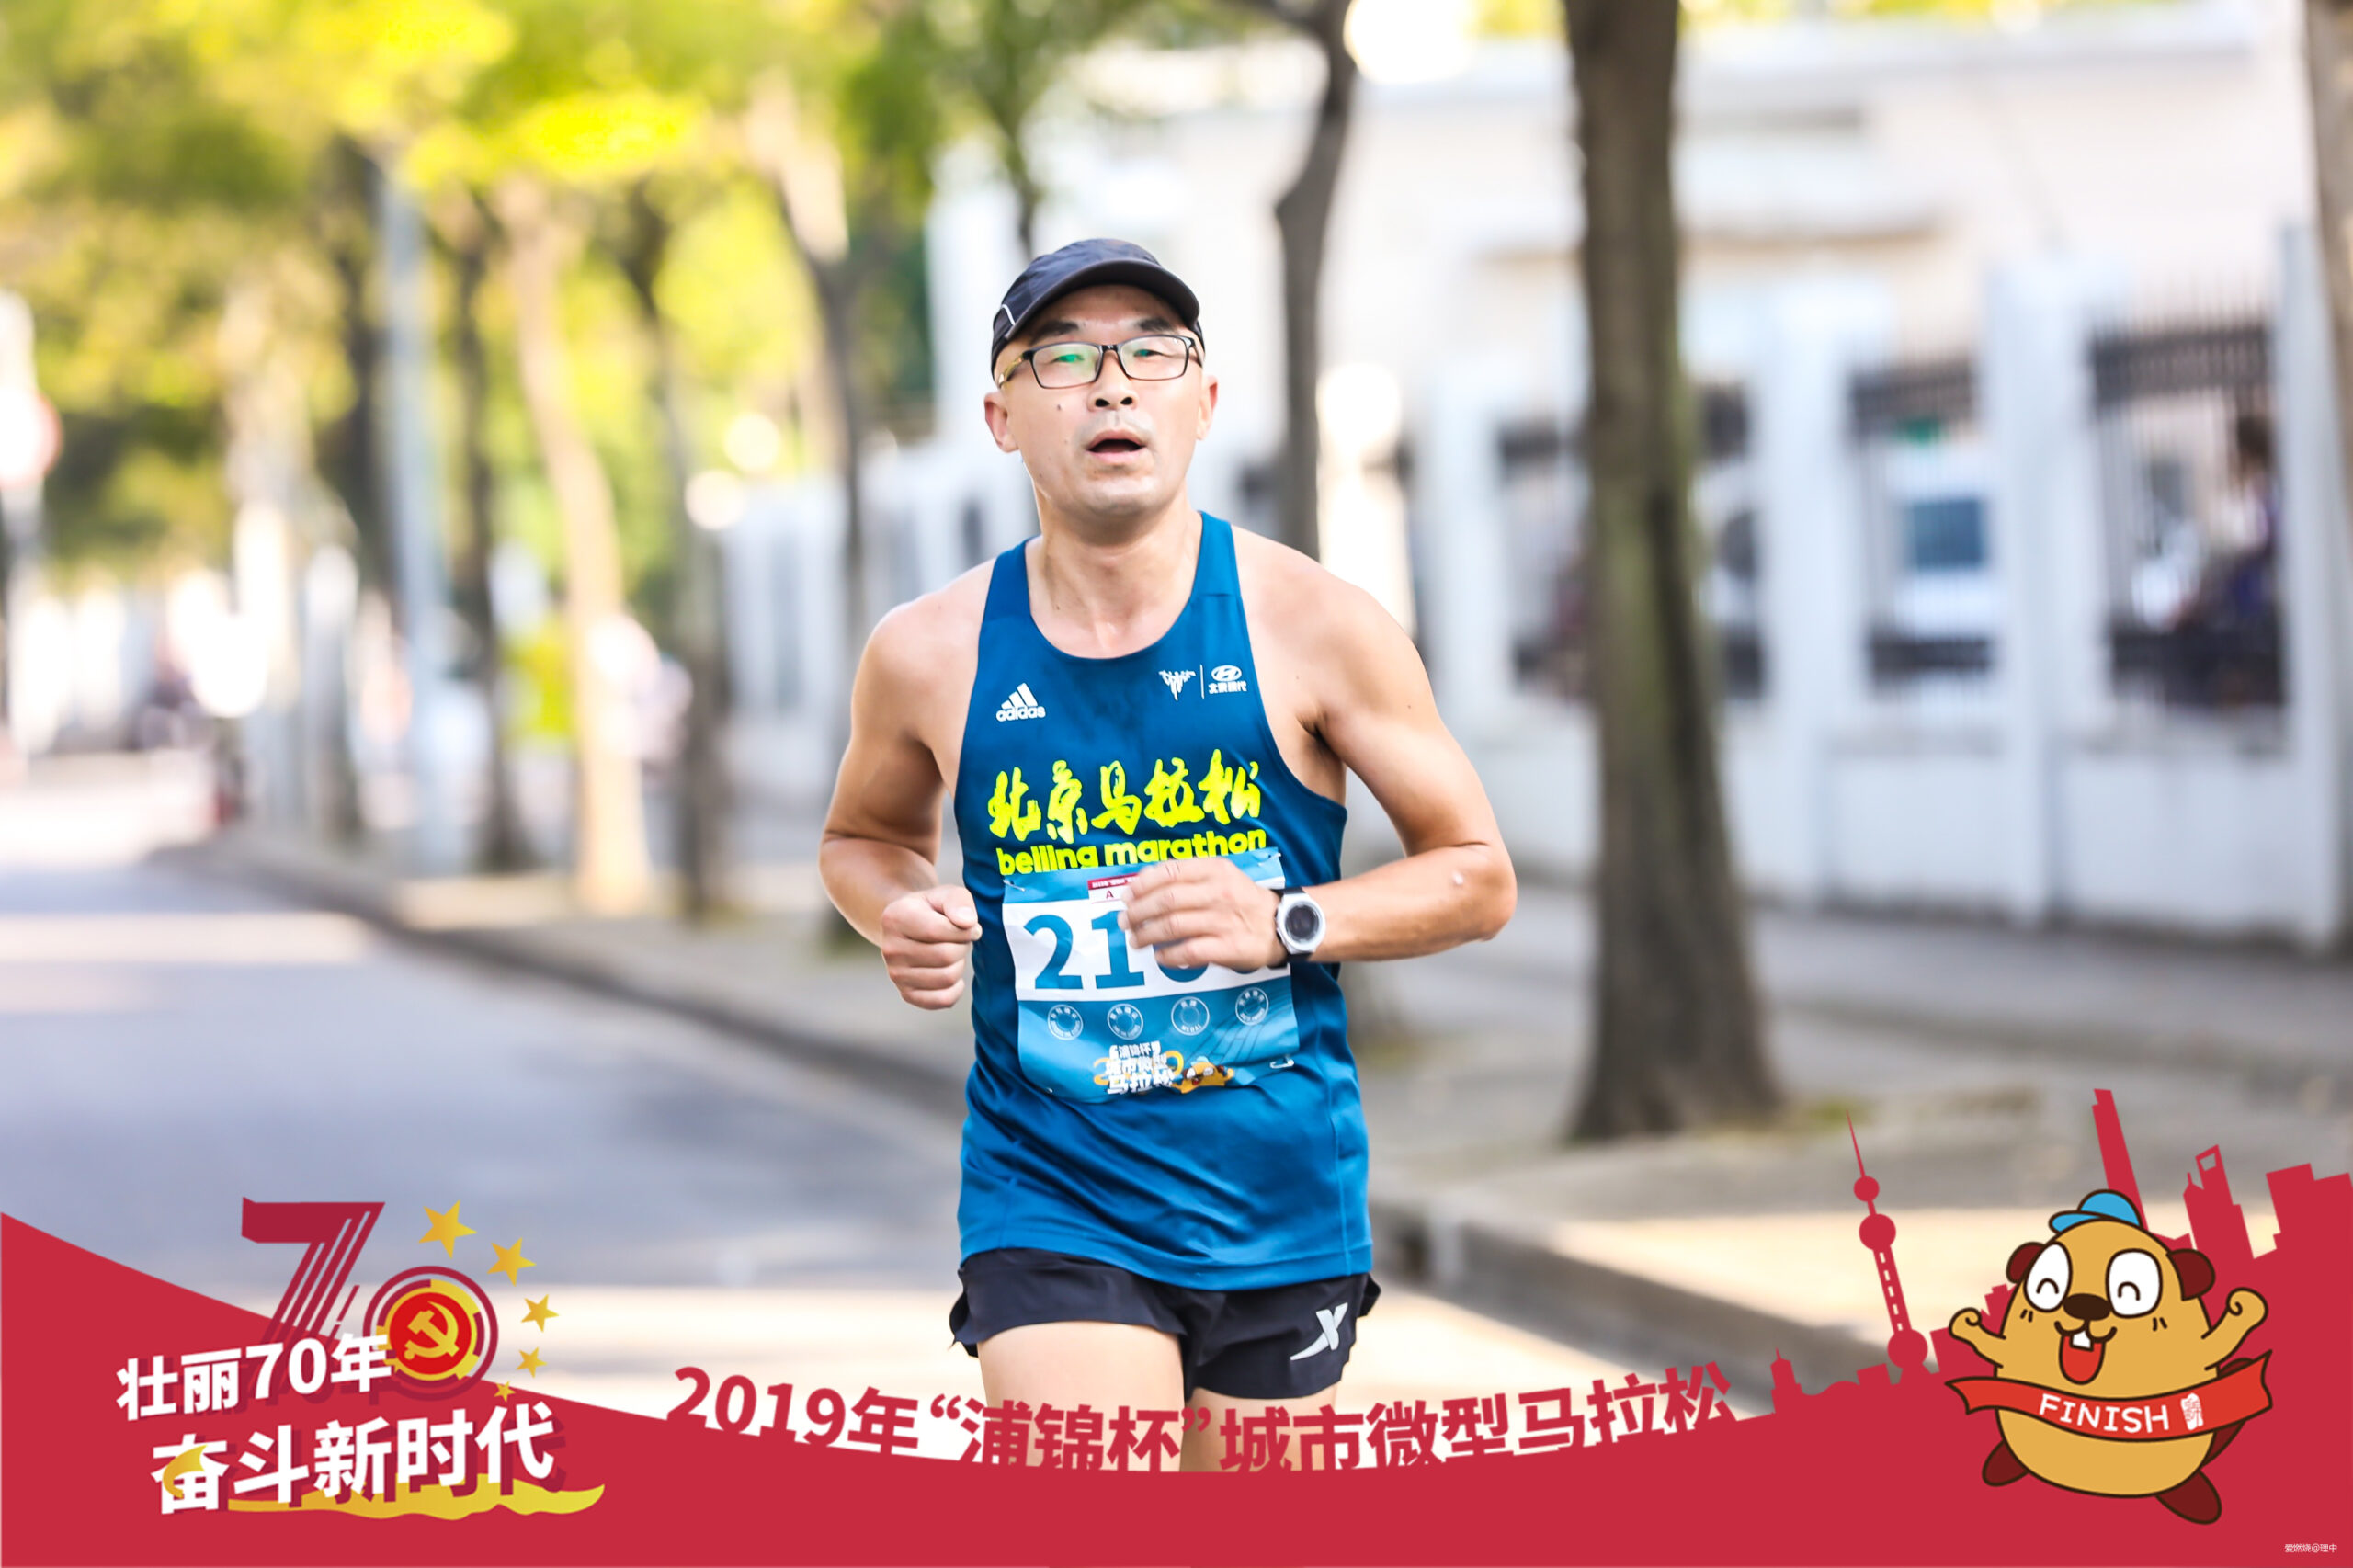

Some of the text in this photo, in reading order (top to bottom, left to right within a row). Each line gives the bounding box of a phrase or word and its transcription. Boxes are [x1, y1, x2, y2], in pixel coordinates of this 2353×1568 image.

[996, 705, 1045, 722] adidas
[987, 749, 1261, 844] 北京马拉松
[1104, 829, 1267, 866] marathon
[1106, 890, 1114, 899] A
